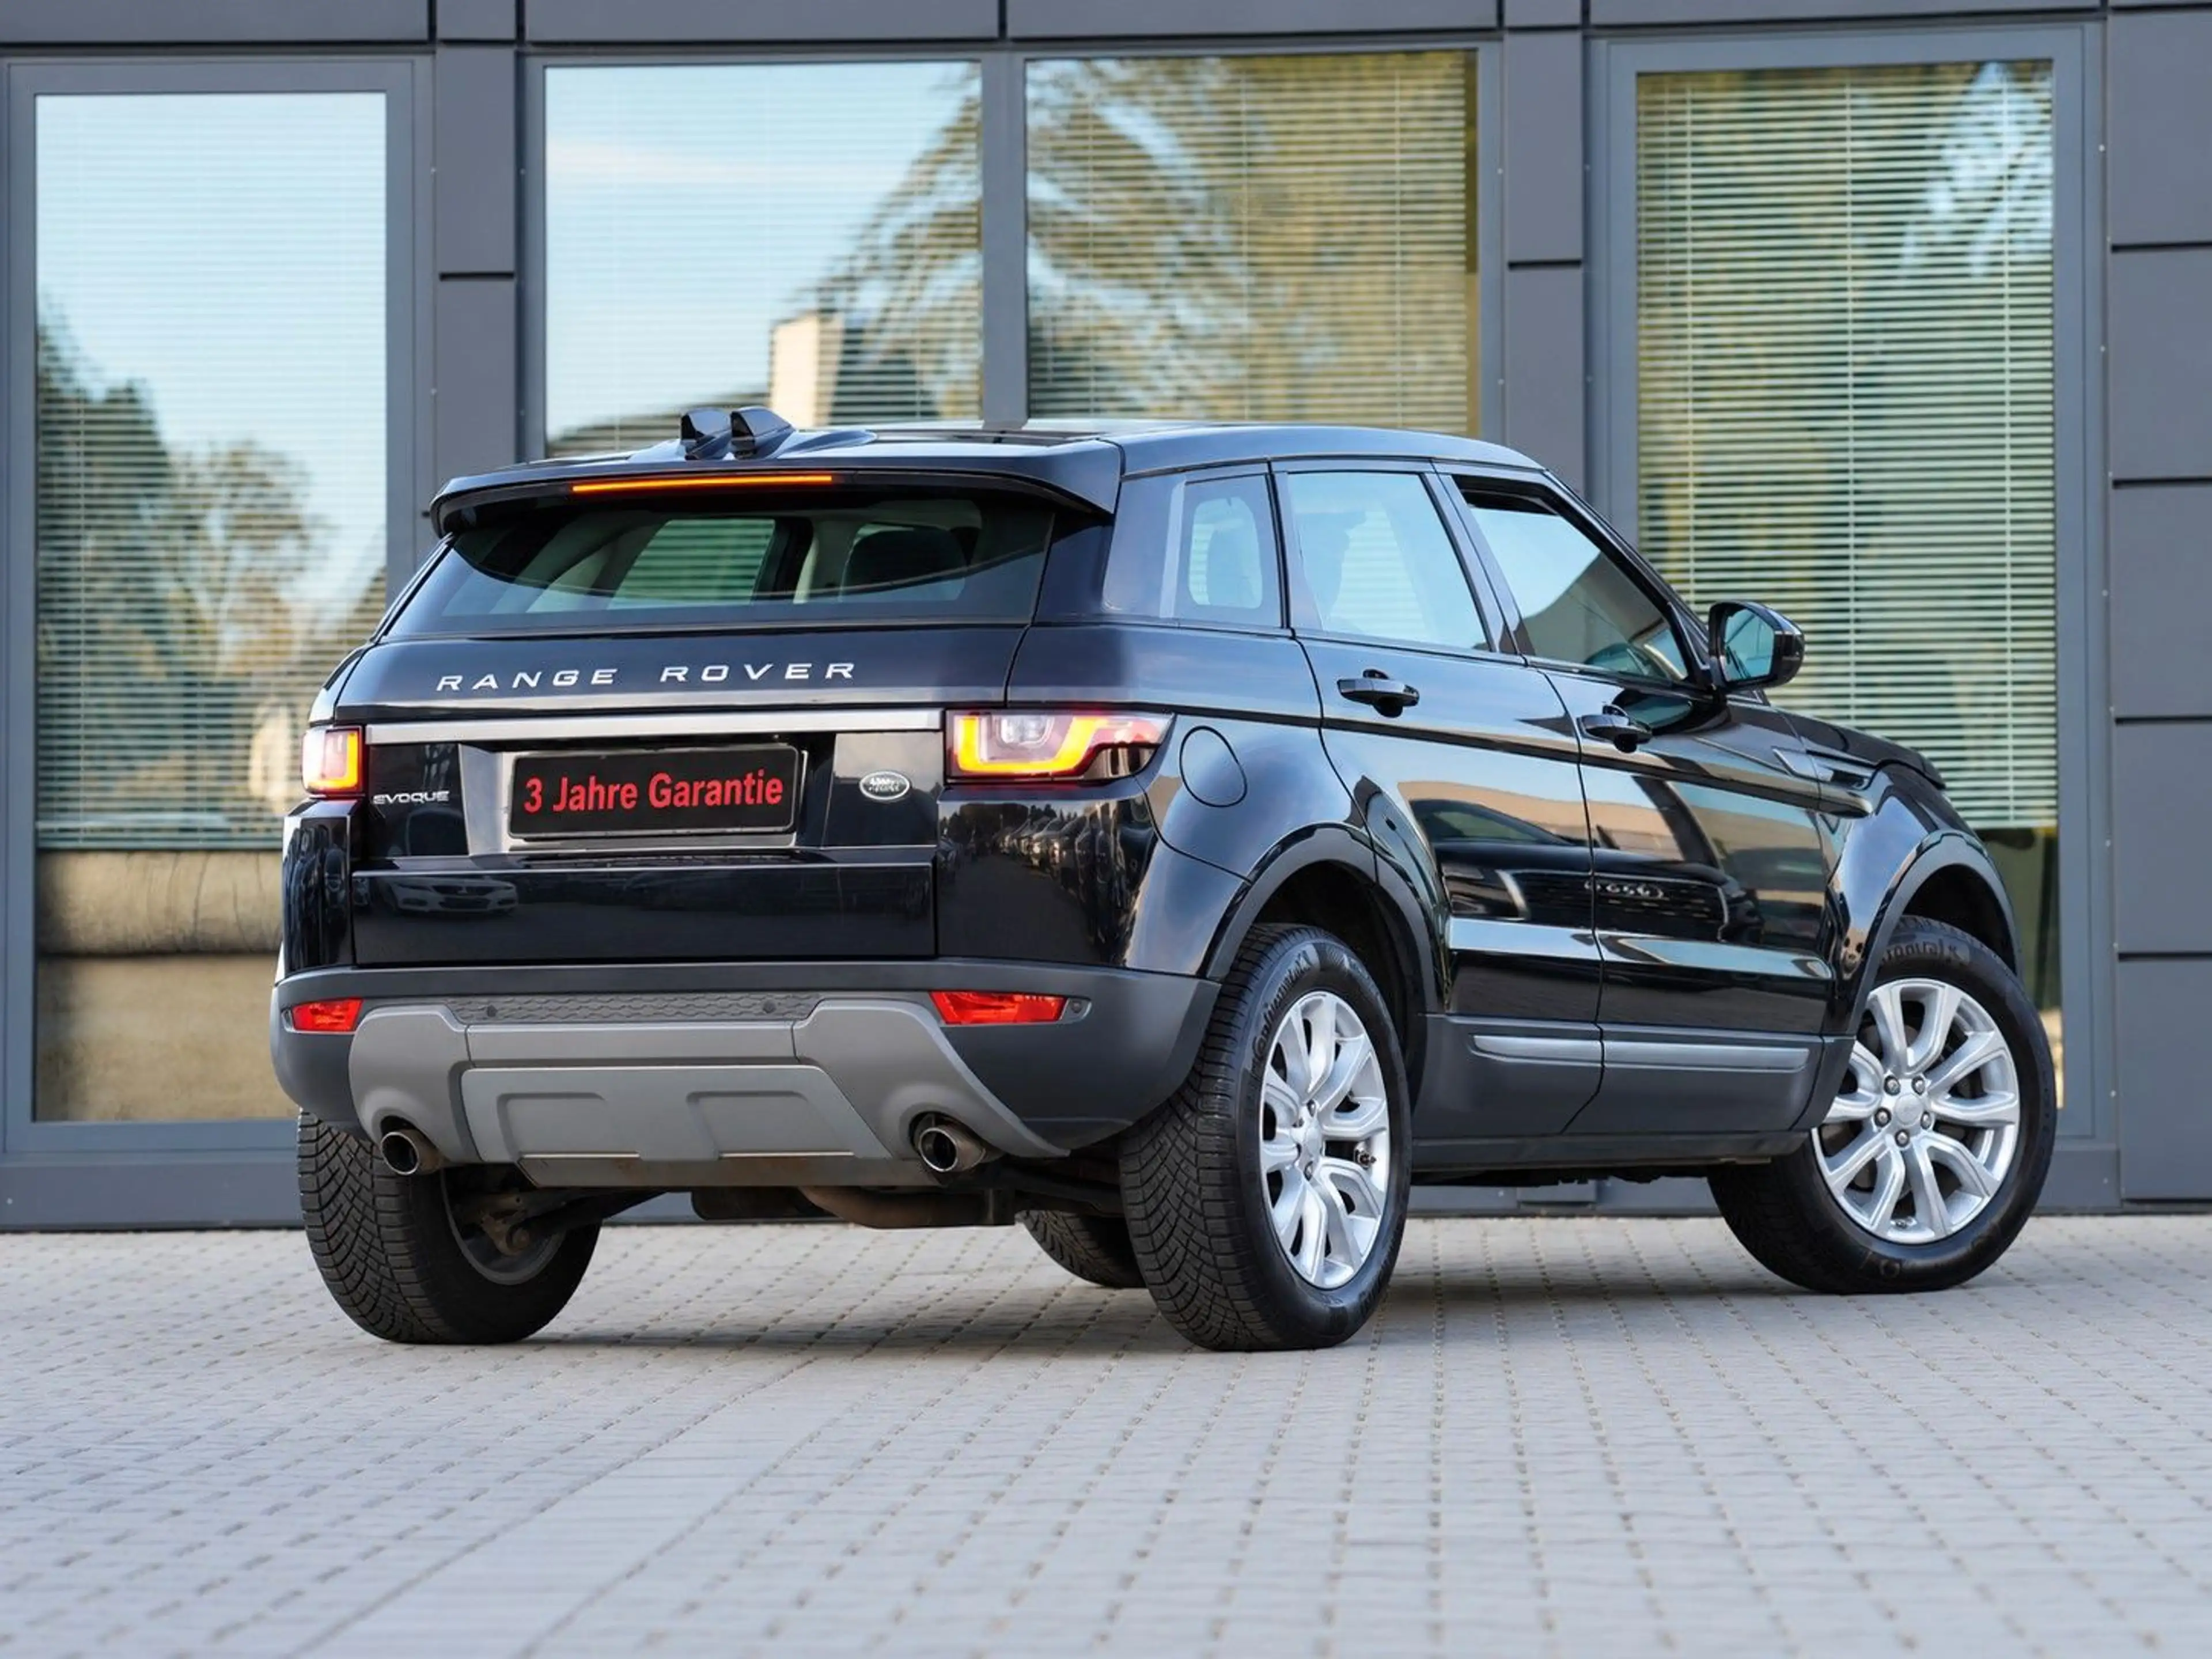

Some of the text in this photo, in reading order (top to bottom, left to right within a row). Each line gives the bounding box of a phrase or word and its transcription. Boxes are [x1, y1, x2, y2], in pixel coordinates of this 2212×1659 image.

[436, 663, 854, 691] RANGE ROVER
[373, 790, 450, 805] EVOQUE
[524, 769, 783, 814] 3 Jahre Garantie
